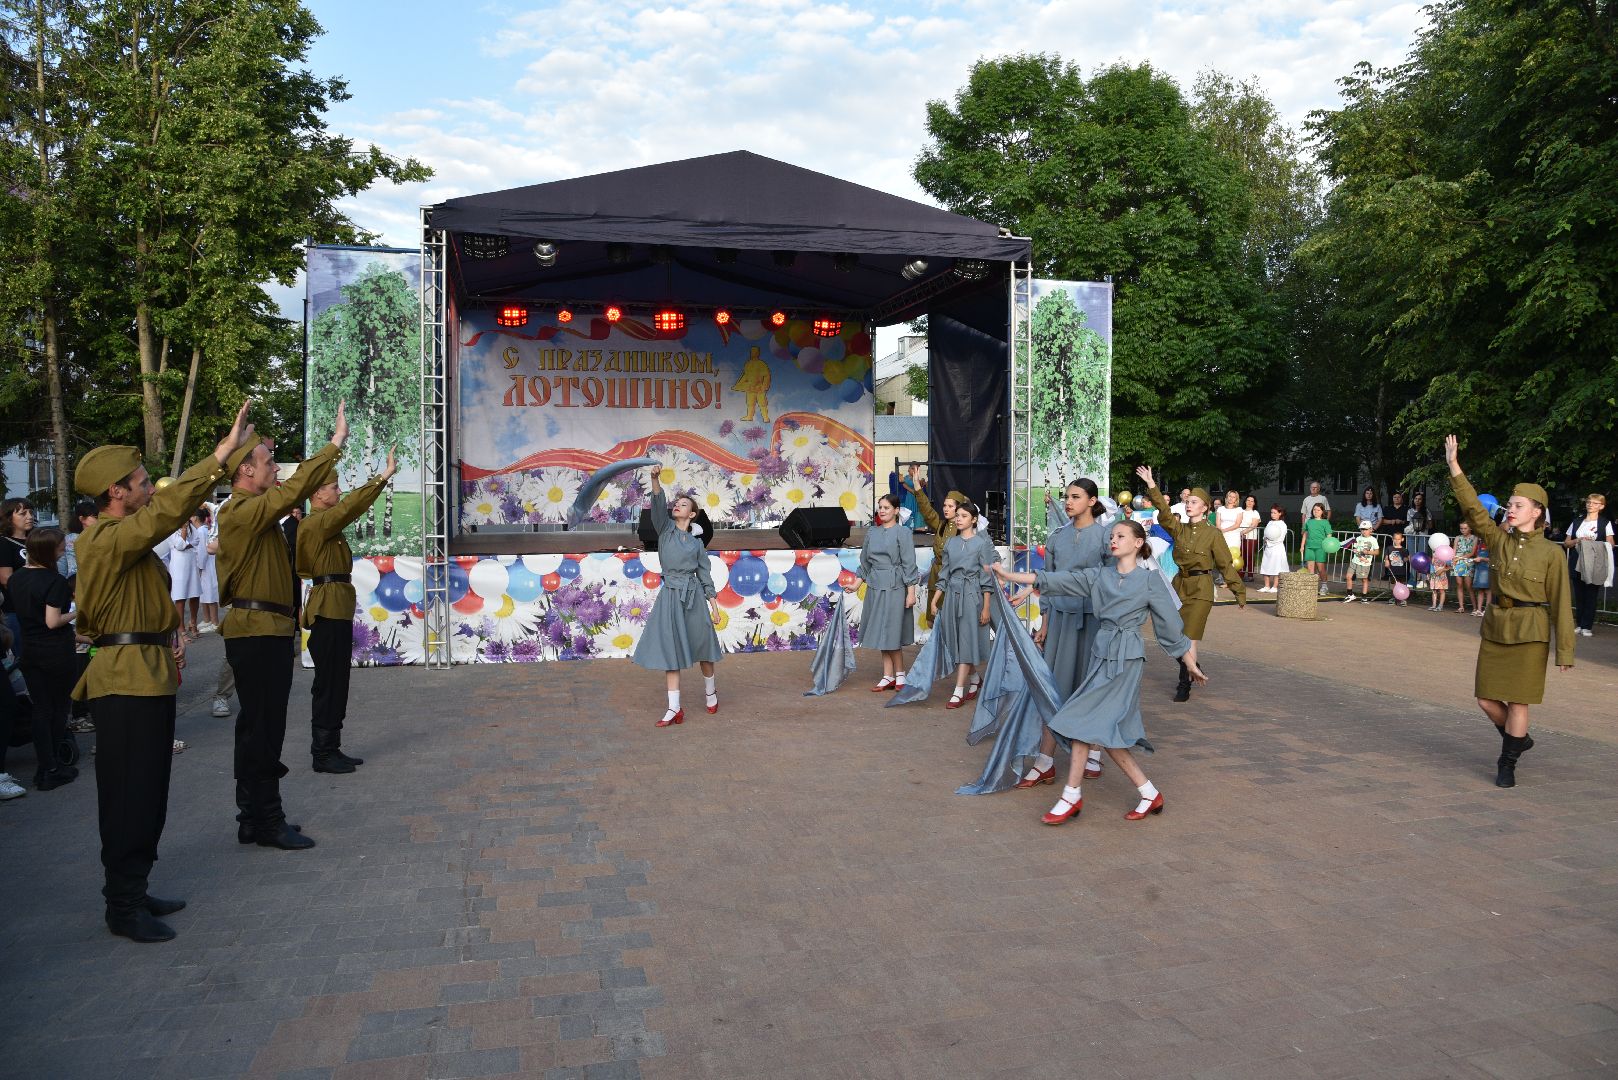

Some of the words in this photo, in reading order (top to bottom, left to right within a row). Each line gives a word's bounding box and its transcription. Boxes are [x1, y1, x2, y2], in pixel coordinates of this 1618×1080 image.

[502, 346, 520, 370] С
[537, 348, 720, 377] ПРАЗДНИКОМ,
[502, 374, 722, 410] ЛОТОШИНО!
